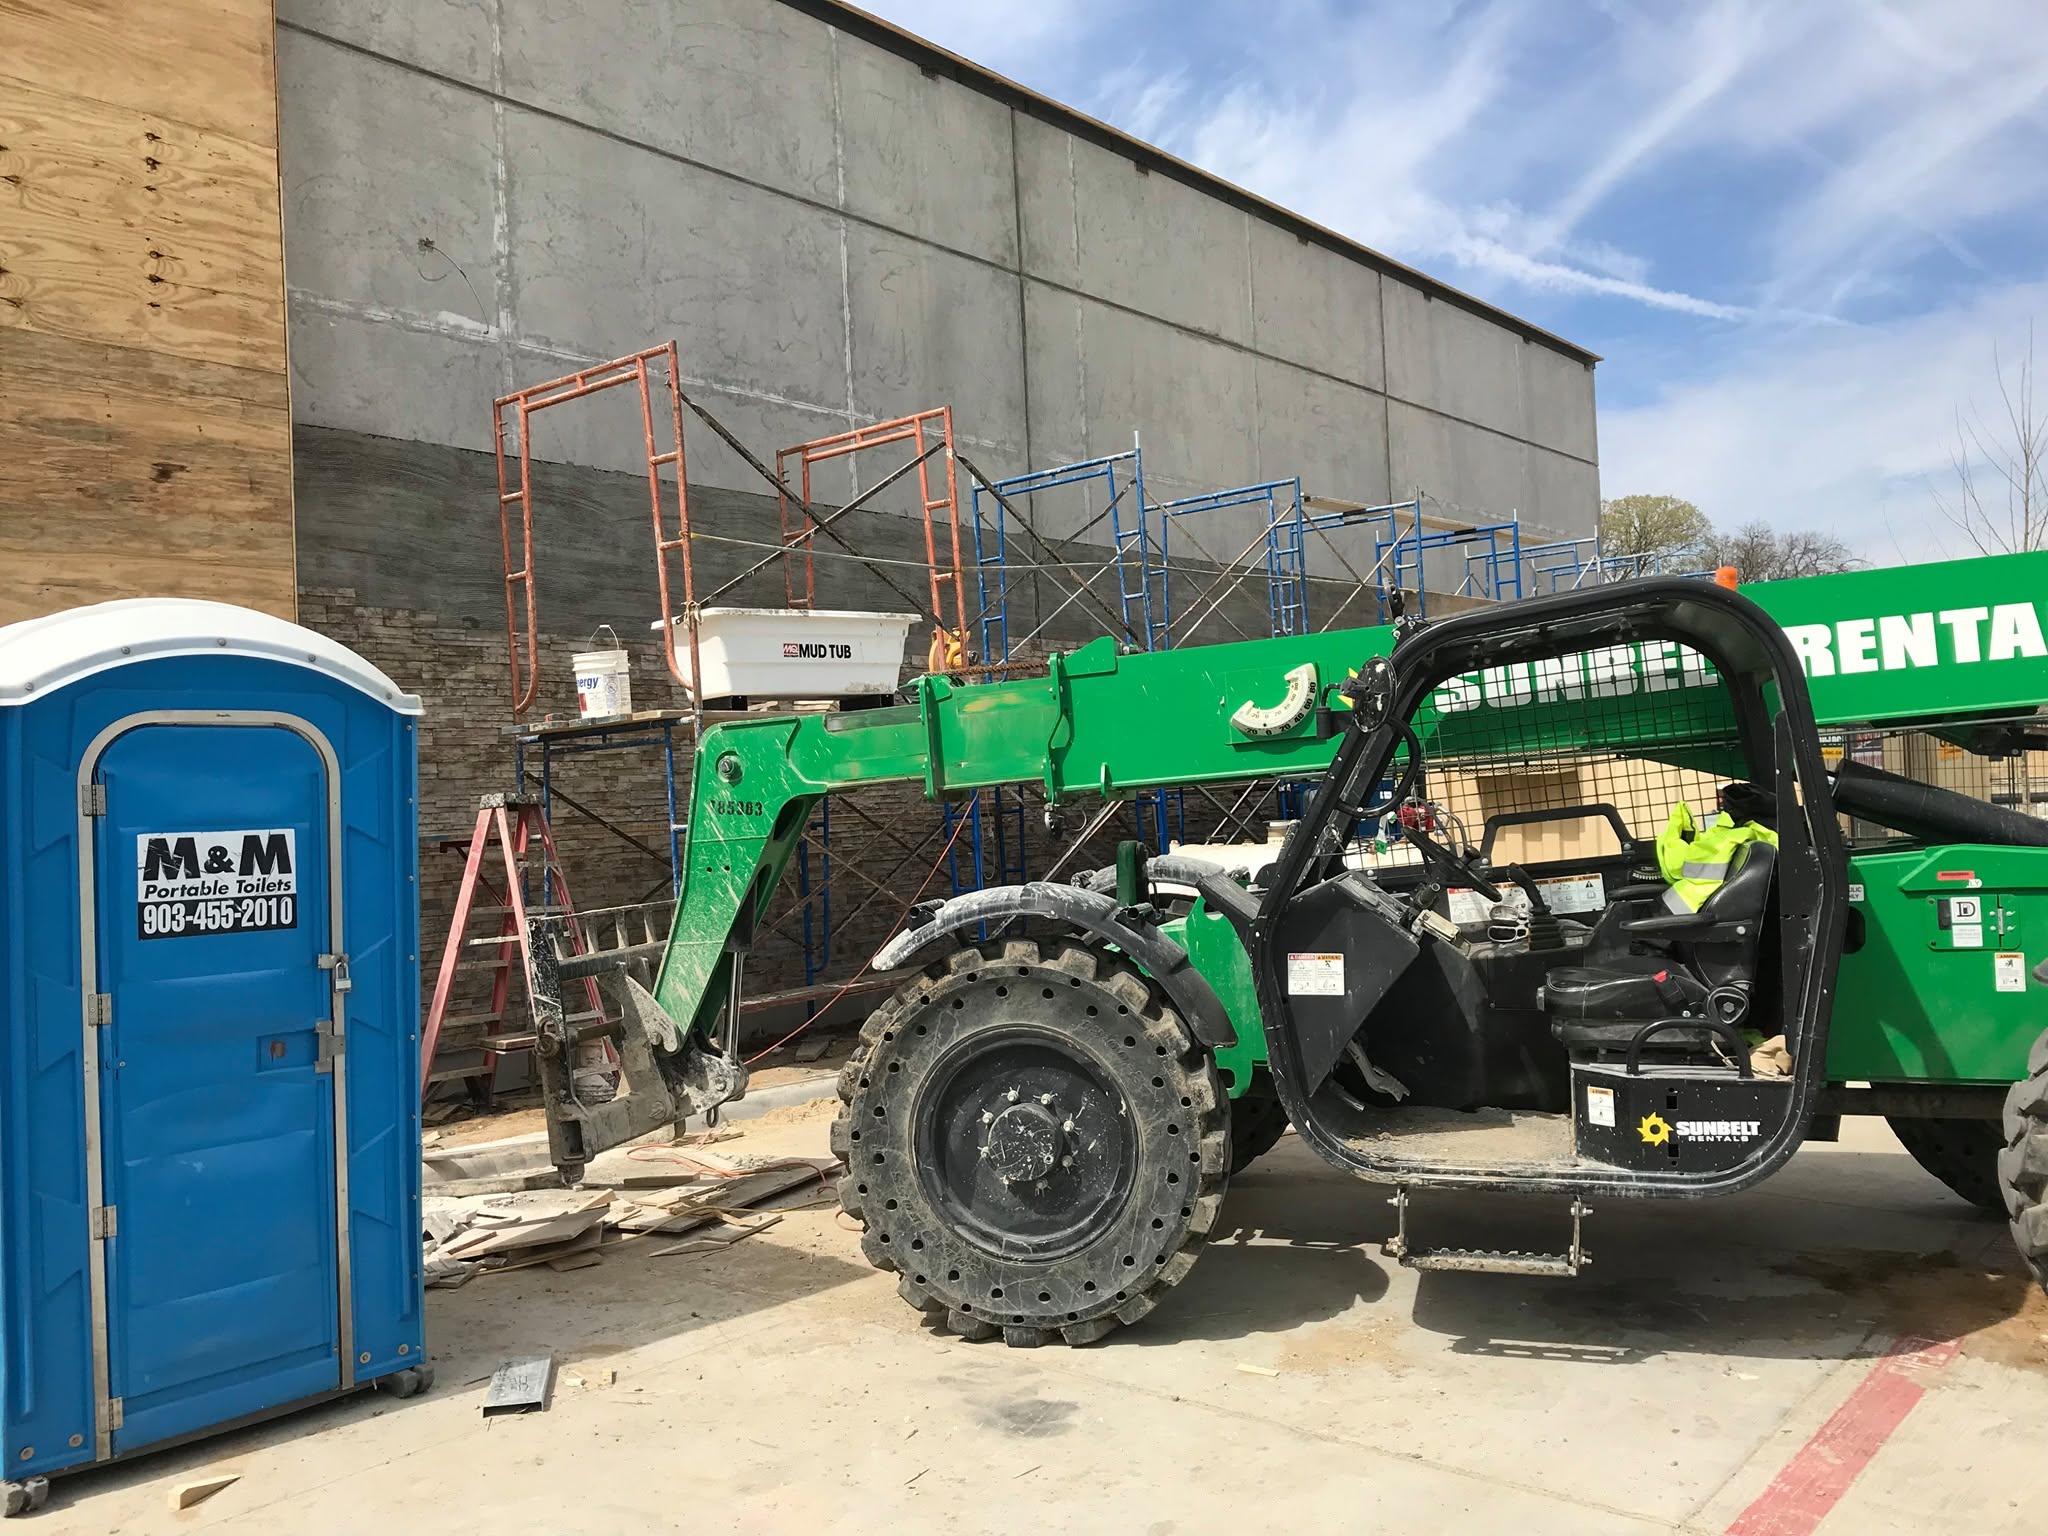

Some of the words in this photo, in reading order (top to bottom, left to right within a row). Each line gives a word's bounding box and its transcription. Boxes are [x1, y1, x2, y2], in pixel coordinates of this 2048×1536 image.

[799, 643, 827, 658] MUD
[829, 644, 852, 658] TUB
[1434, 640, 1719, 713] SUNBEL
[1782, 602, 2048, 677] RENTA
[1279, 723, 1291, 732] 20
[1294, 712, 1304, 723] 40
[1304, 698, 1313, 710] 60
[1309, 681, 1316, 694] 80
[143, 833, 292, 881] M&M
[144, 880, 229, 899] Portable
[236, 877, 292, 894] Toilets
[143, 896, 293, 935] 903-455-2010
[1957, 902, 1976, 917] D
[1676, 1121, 1761, 1136] SUNBELT
